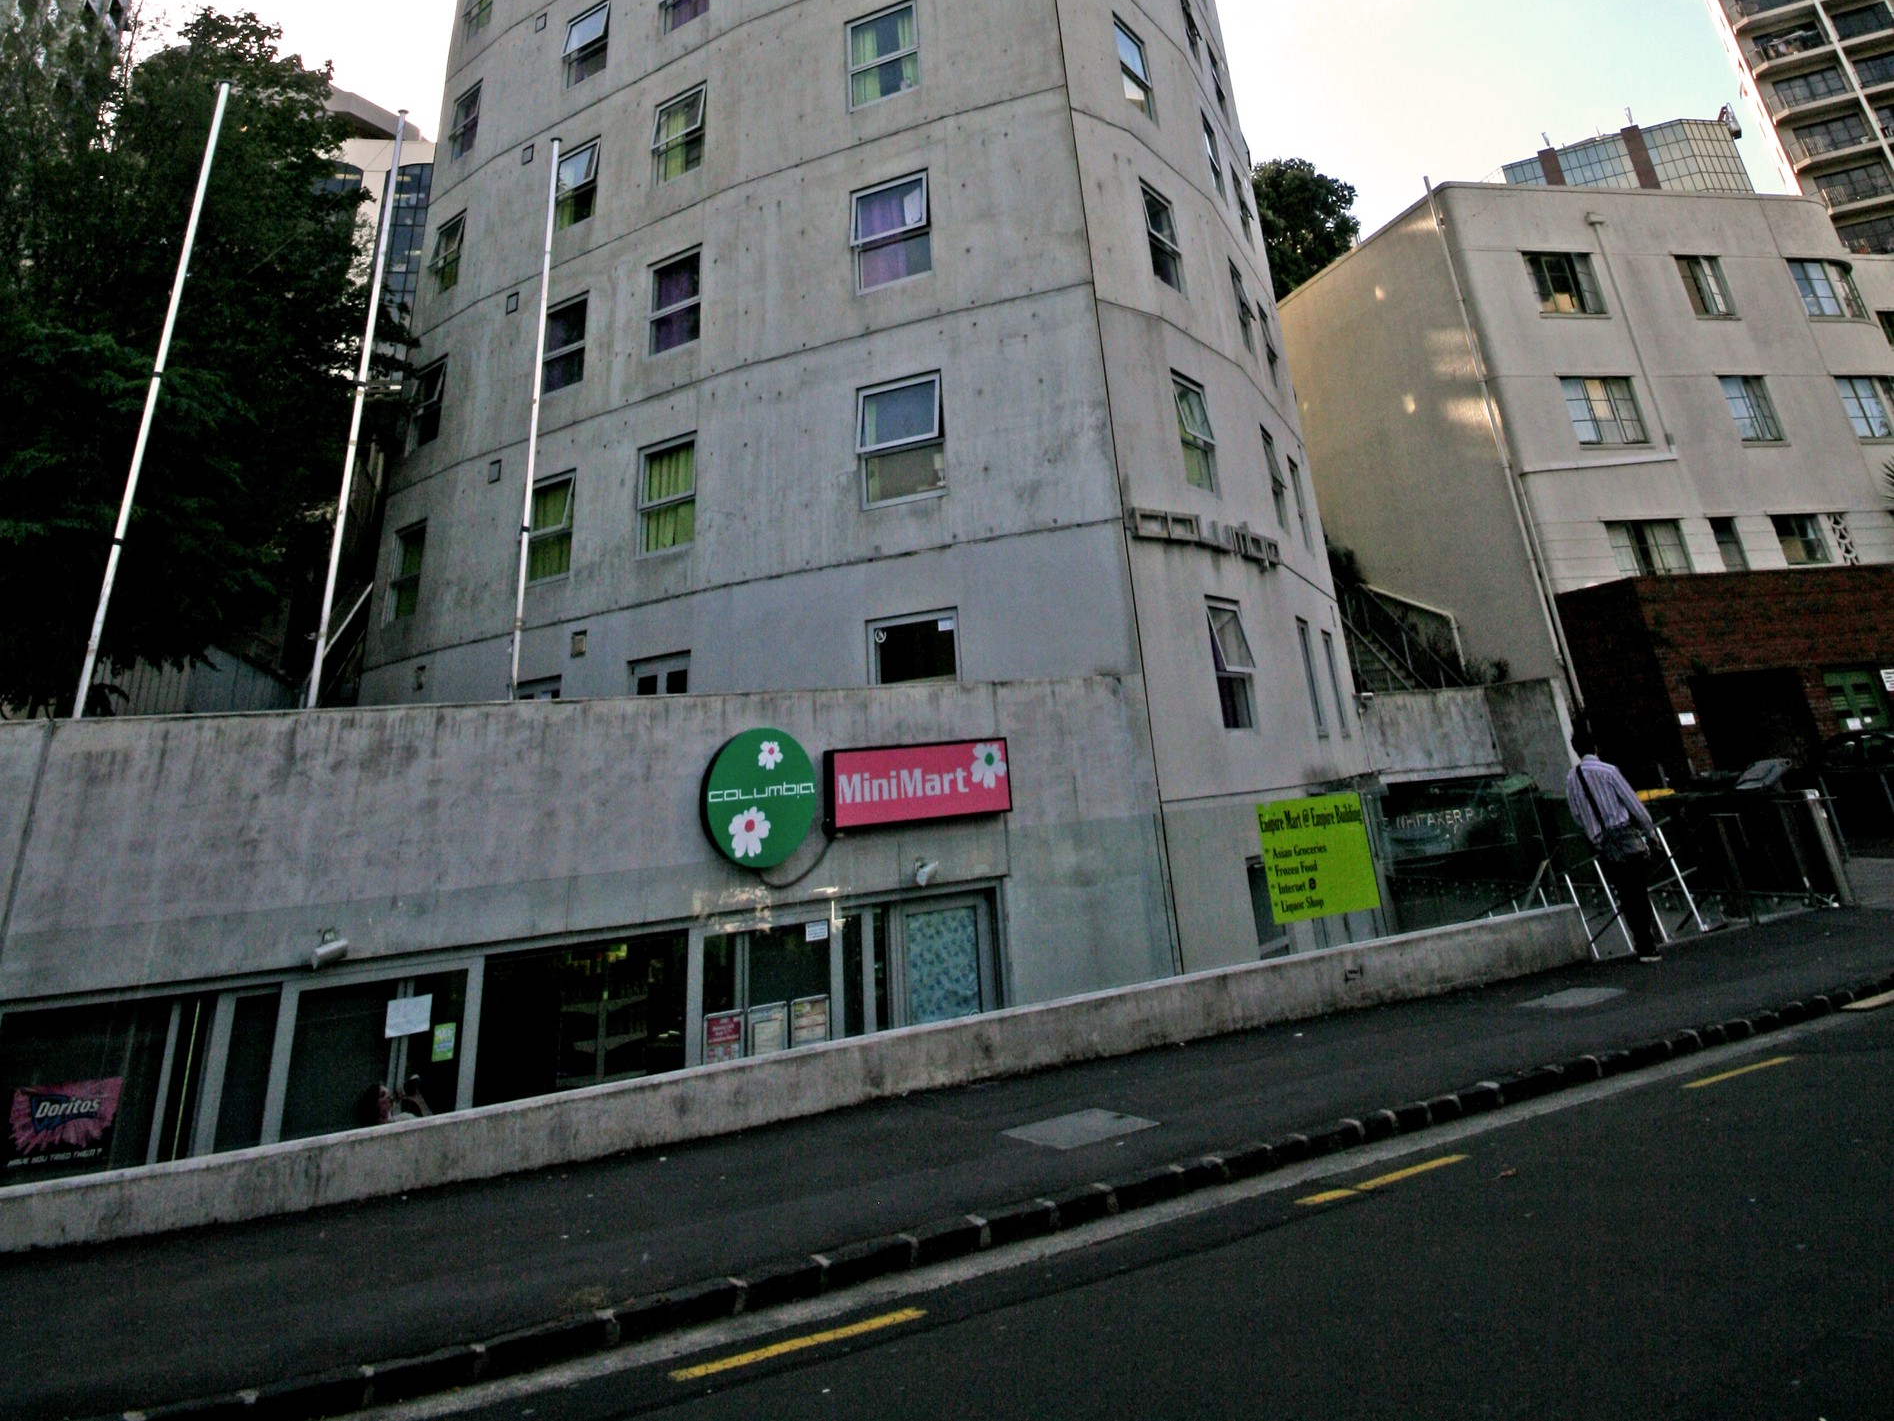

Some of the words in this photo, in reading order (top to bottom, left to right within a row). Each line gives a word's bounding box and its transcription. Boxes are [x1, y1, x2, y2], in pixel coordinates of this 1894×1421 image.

[838, 768, 970, 804] MiniMart
[1258, 813, 1285, 835] Empire
[1284, 810, 1302, 830] Mart
[1310, 807, 1336, 829] Empire
[1272, 847, 1293, 860] Asian
[1294, 843, 1328, 857] Groceries
[1275, 864, 1300, 877] Frozen
[1300, 860, 1318, 874] Food
[1278, 882, 1306, 895] Internet
[1281, 900, 1305, 914] Liquor
[1305, 896, 1325, 910] Shop
[35, 1098, 101, 1118] Doritos
